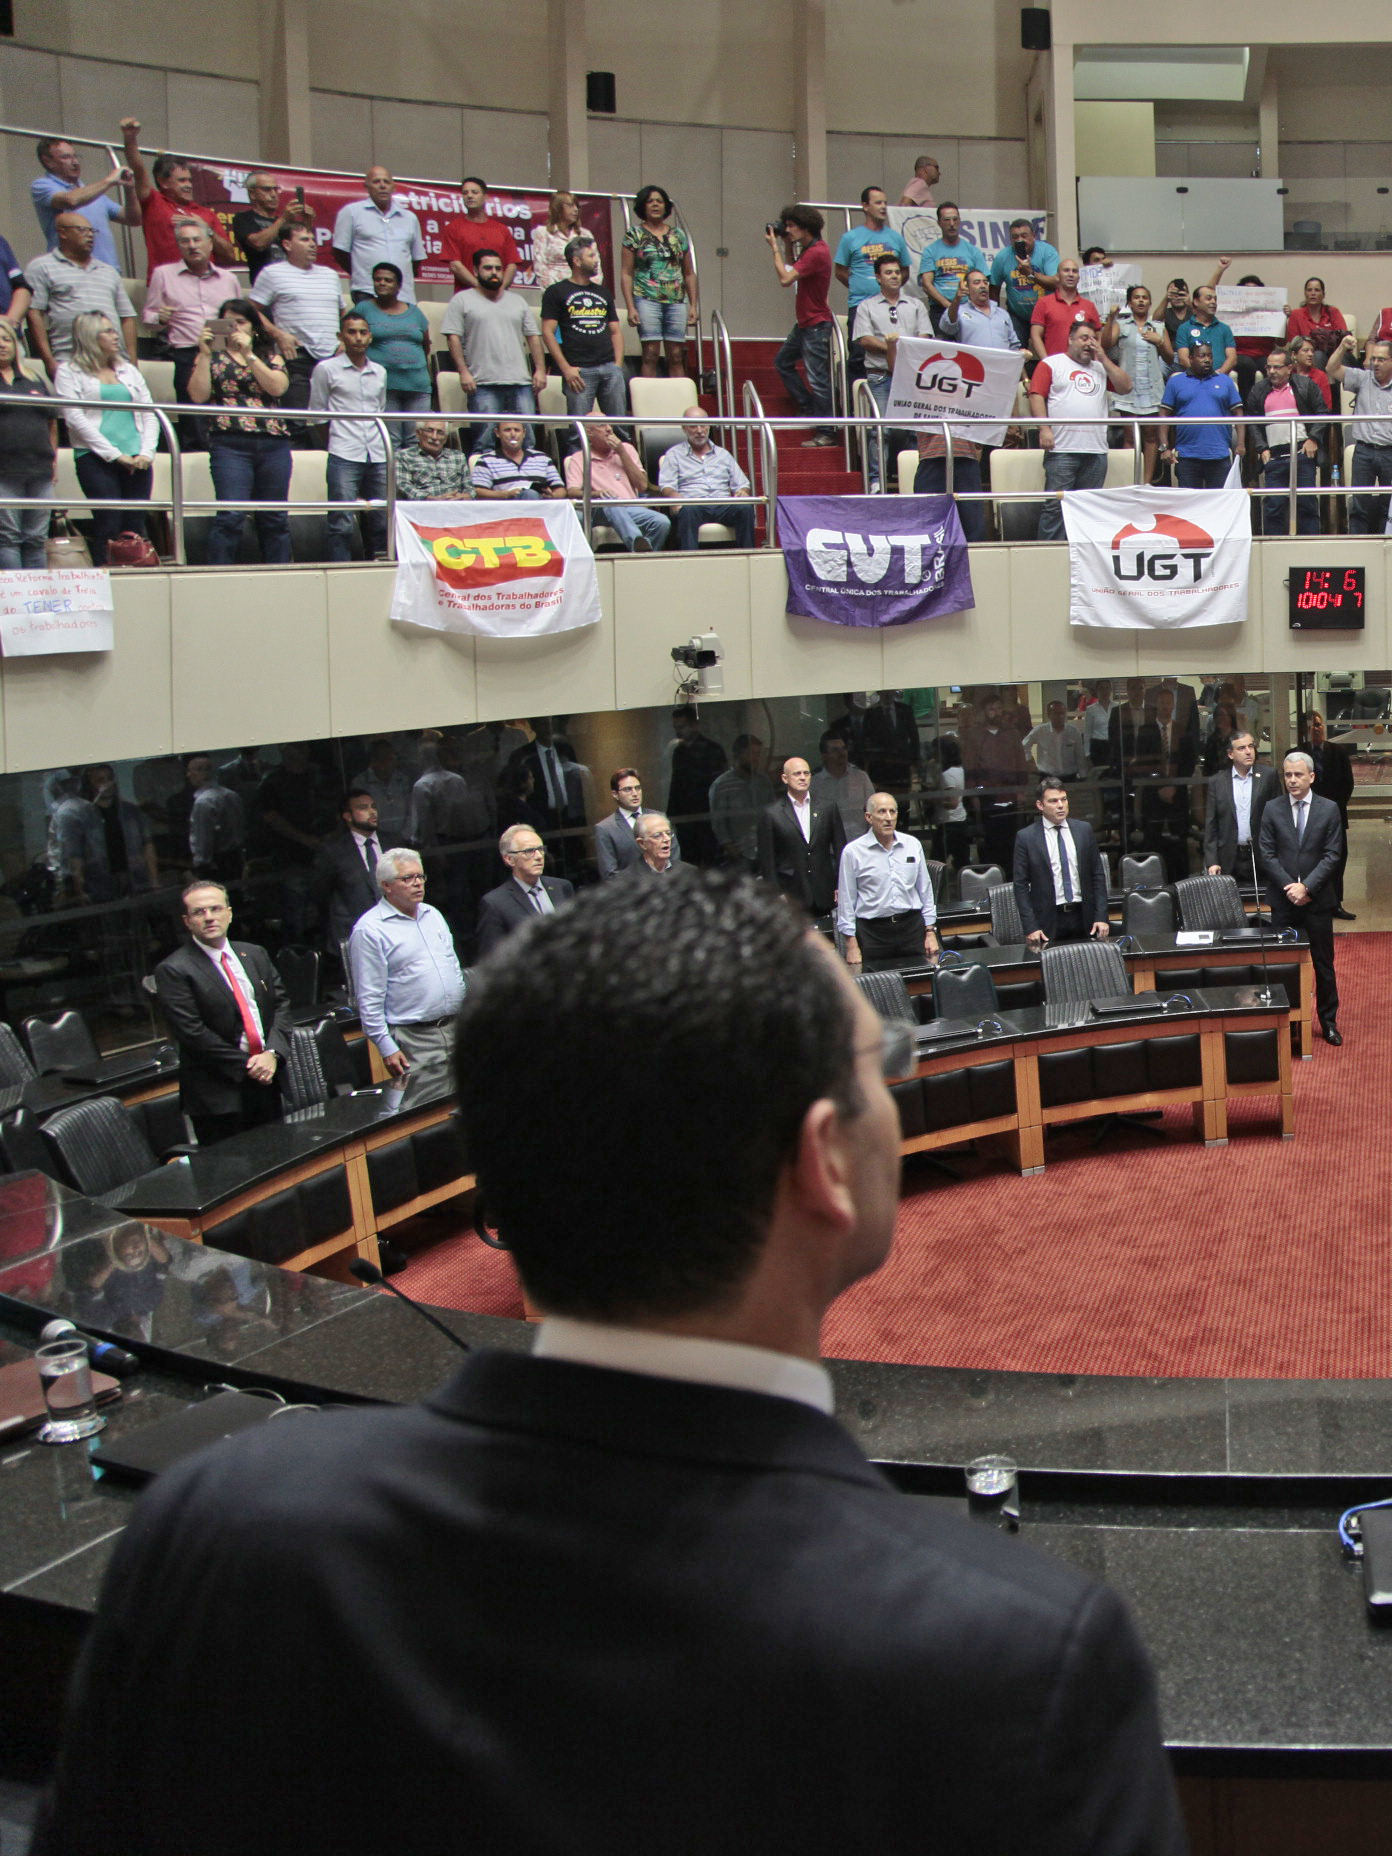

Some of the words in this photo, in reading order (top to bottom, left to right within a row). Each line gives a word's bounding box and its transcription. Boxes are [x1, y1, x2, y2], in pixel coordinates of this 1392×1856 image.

[398, 191, 532, 220] etricitrios
[915, 371, 984, 399] UGT
[894, 399, 912, 408] UNIÃO
[913, 402, 932, 411] GERAL
[934, 404, 947, 413] DOS
[432, 535, 552, 570] CTB
[806, 528, 932, 584] CUT
[1112, 551, 1214, 583] UGT
[28, 585, 58, 596] cavalo
[62, 587, 72, 595] de
[473, 593, 492, 601] dos
[496, 587, 565, 601] Trabalhadores
[805, 584, 839, 594] CENTRAL
[840, 586, 866, 596] ÚNICA
[1091, 587, 1115, 595] UNIÃO
[1169, 582, 1240, 596] TRABALHADORES
[23, 599, 73, 614] TEMER
[438, 600, 444, 608] e
[519, 601, 532, 610] do
[534, 596, 563, 609] Brasil
